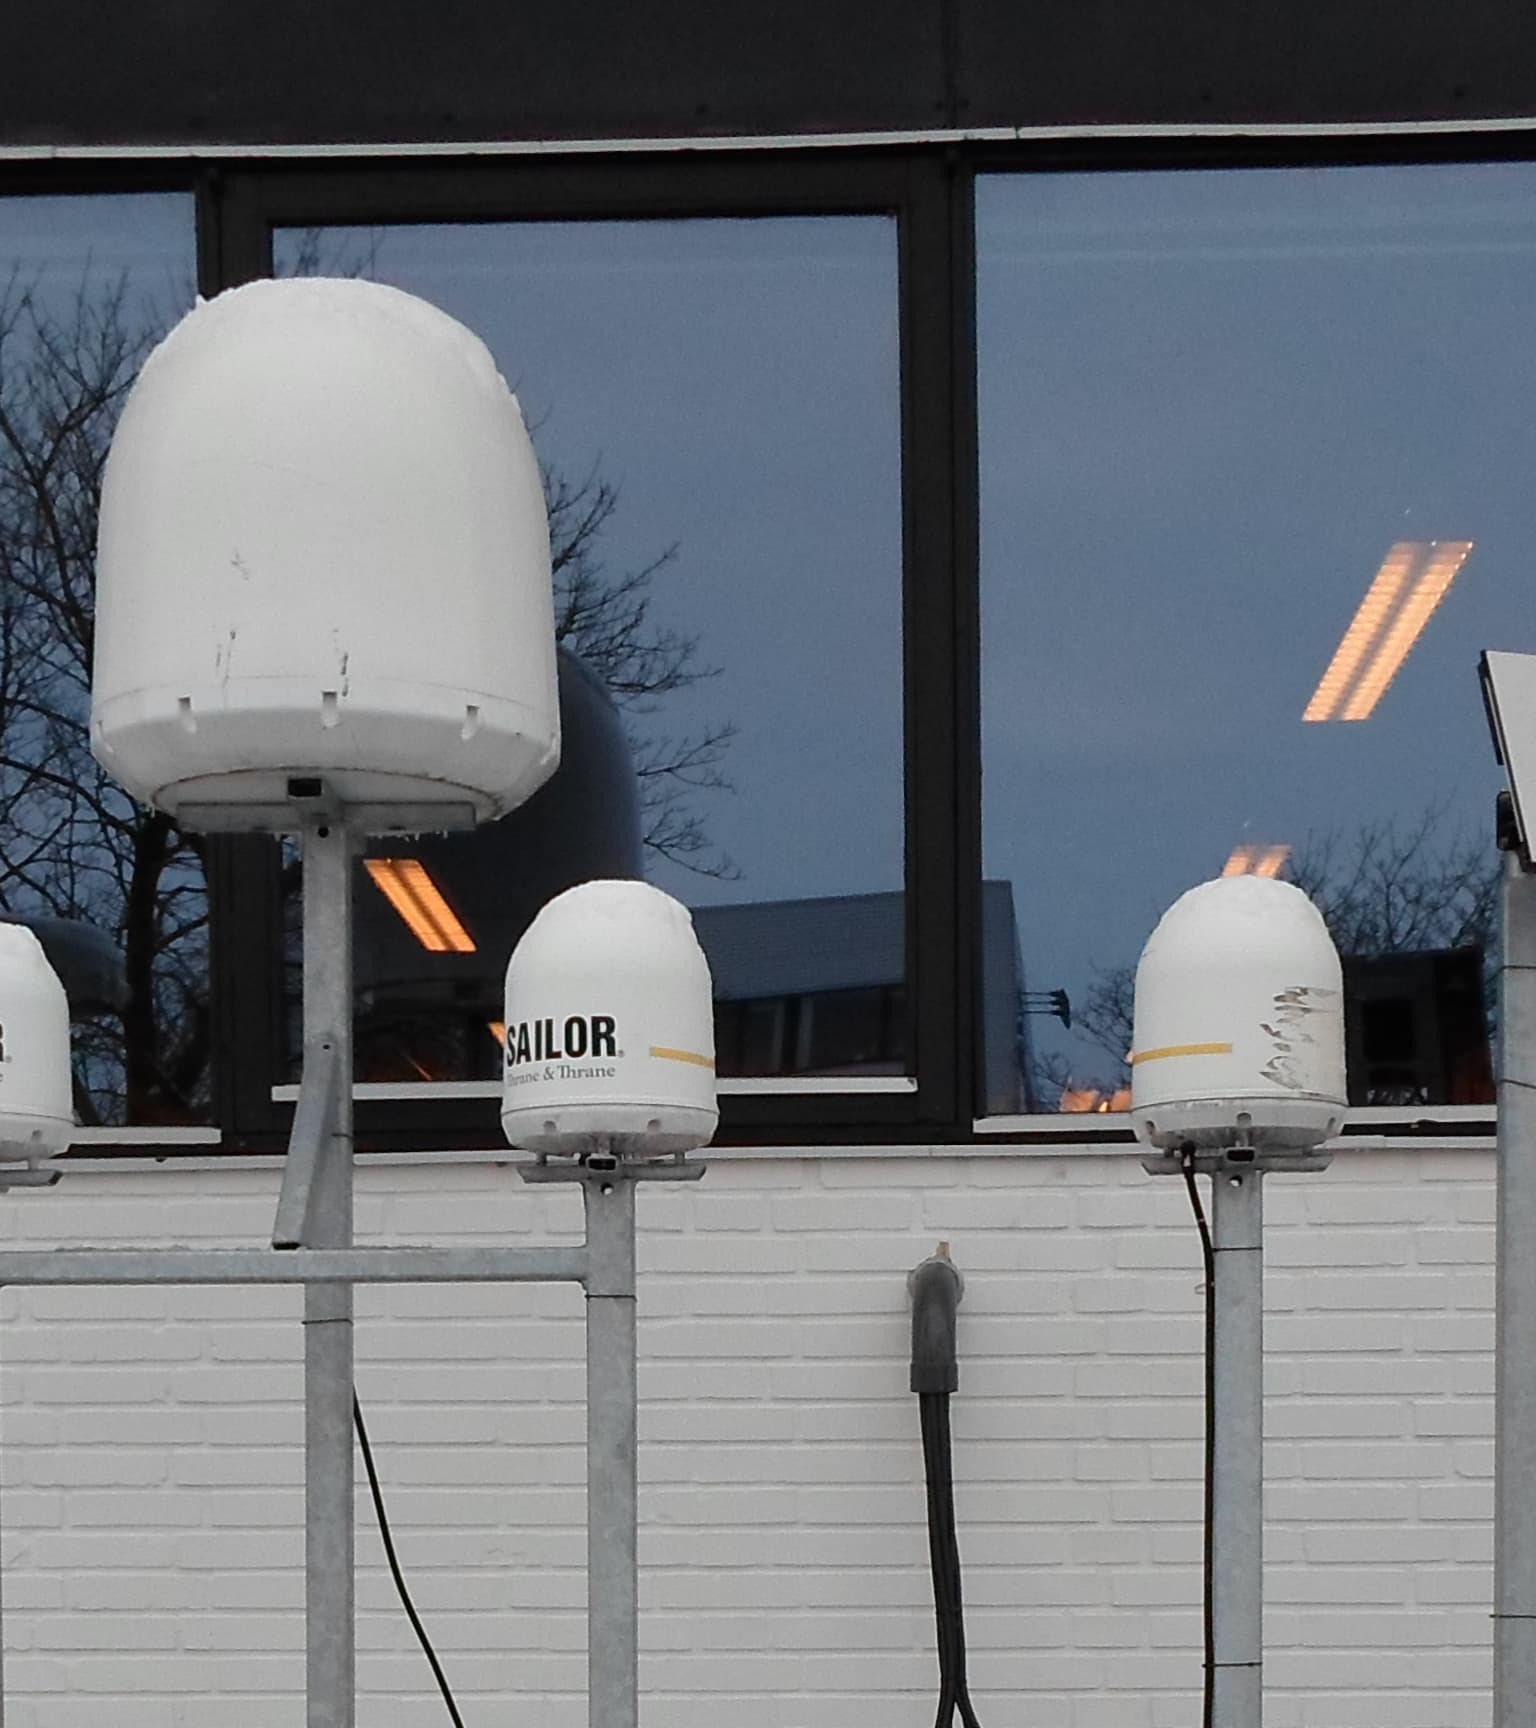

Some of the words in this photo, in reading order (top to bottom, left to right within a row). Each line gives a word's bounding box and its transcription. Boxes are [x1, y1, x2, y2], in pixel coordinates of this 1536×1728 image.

[507, 1015, 617, 1067] SAILOR
[543, 1066, 555, 1081] &
[557, 1064, 616, 1079] Thrane
